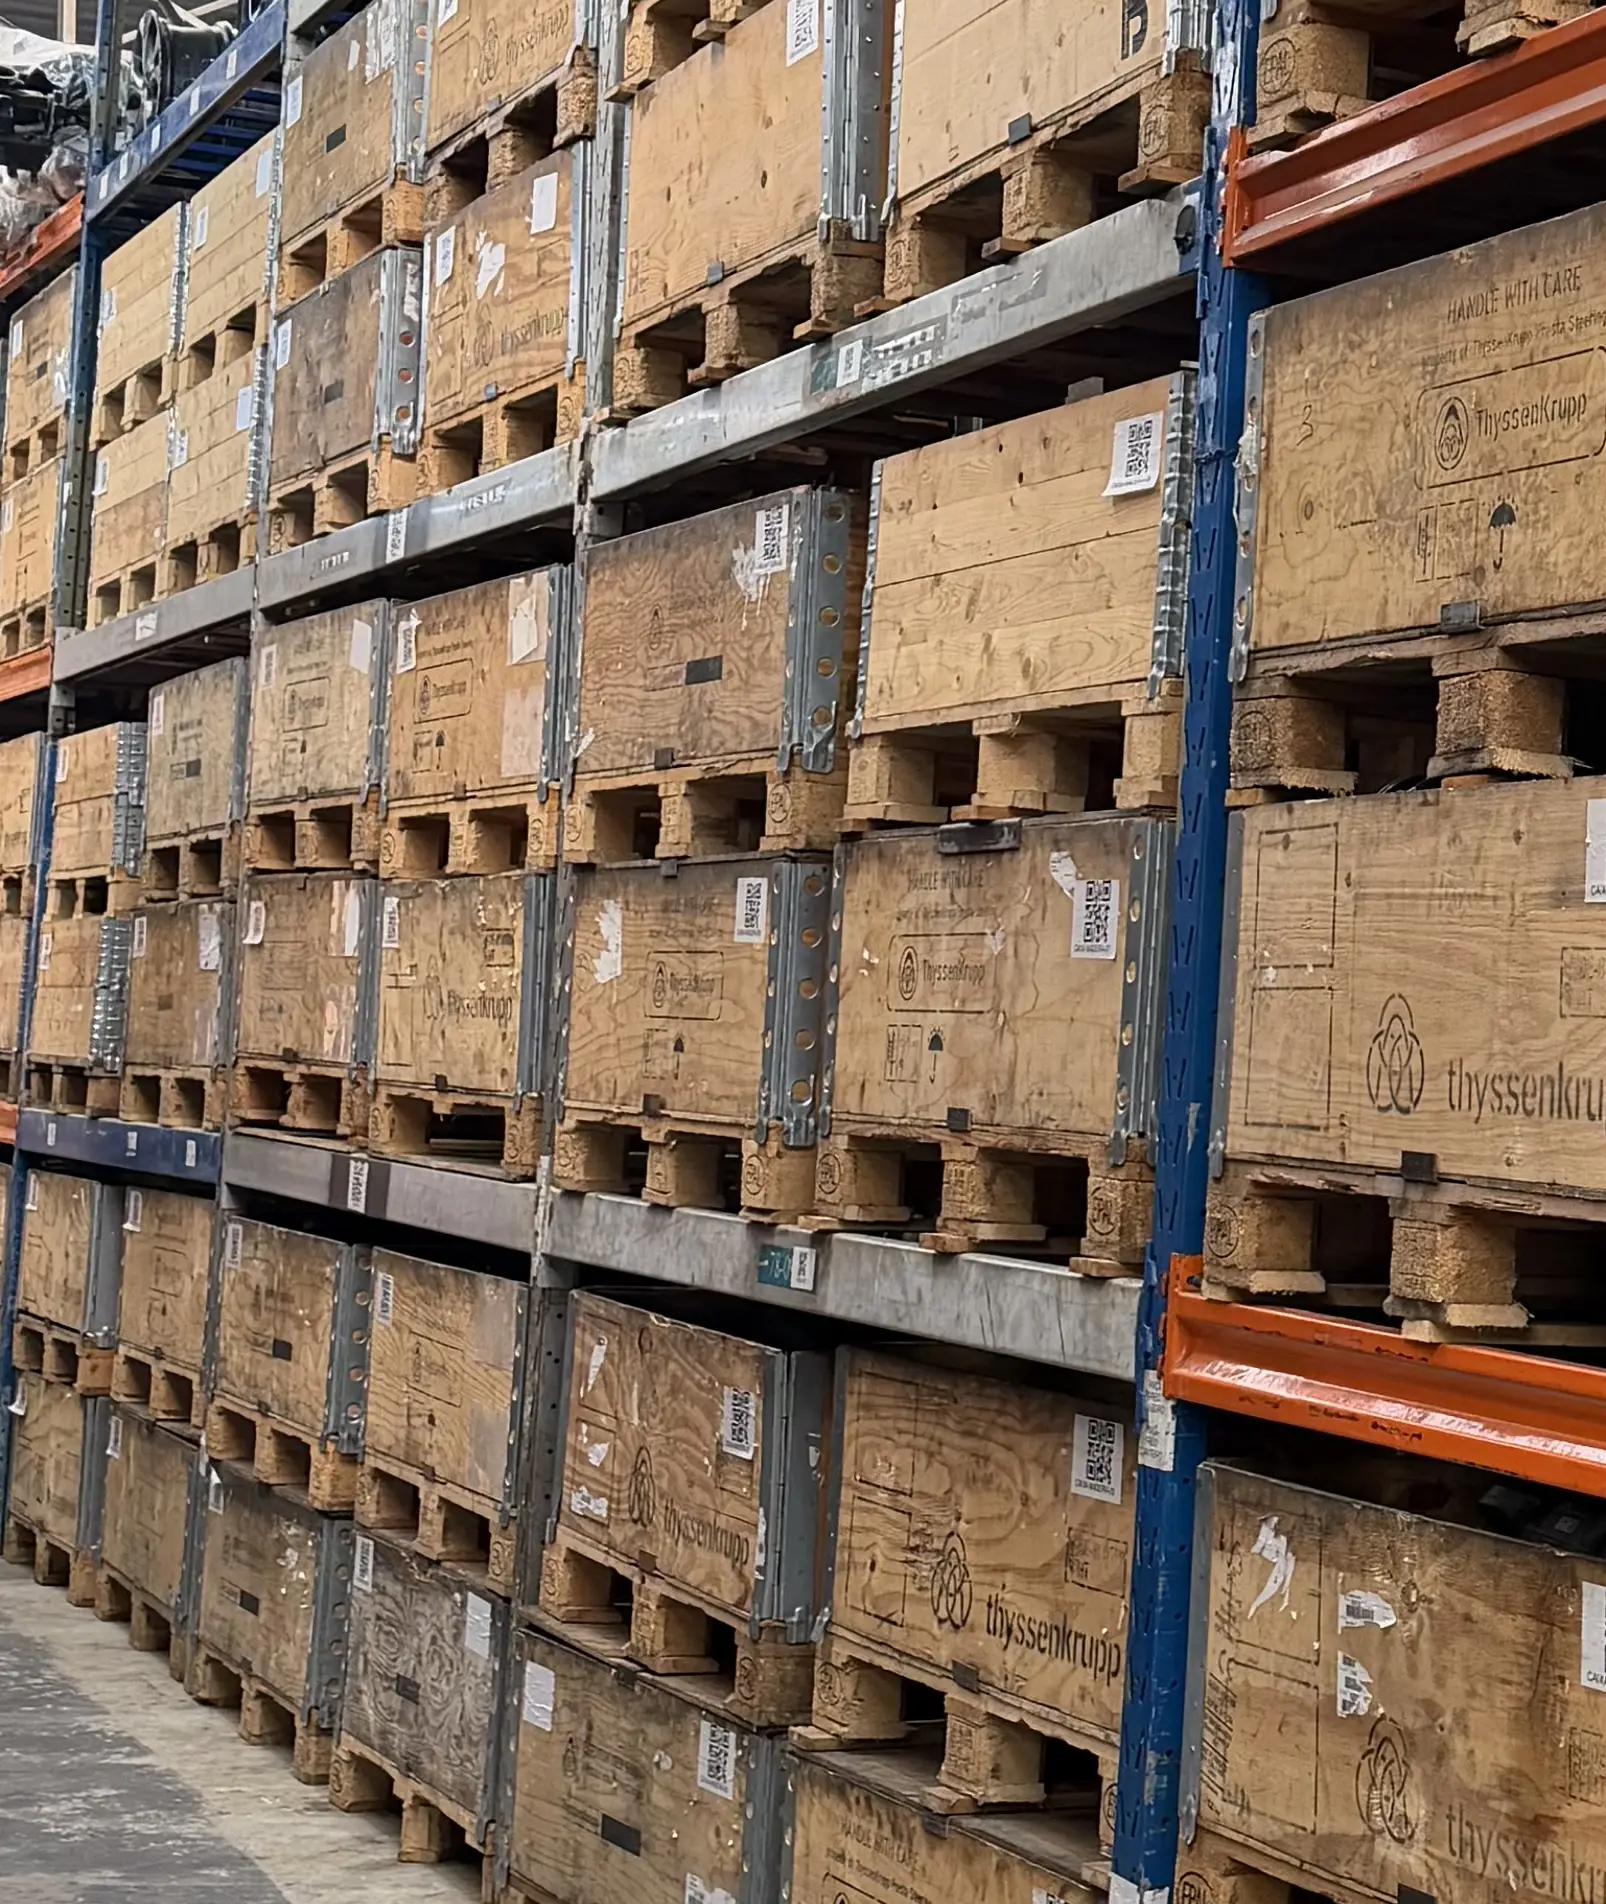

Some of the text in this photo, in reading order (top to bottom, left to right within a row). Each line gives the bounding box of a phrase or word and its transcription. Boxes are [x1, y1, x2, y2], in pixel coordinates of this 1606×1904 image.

[1446, 265, 1583, 326] HANDLE WITH CARE
[1476, 391, 1588, 441] ThyssenKrupp
[664, 1503, 750, 1570] thyssenkrupp
[985, 1597, 1121, 1686] thyssenkrupp
